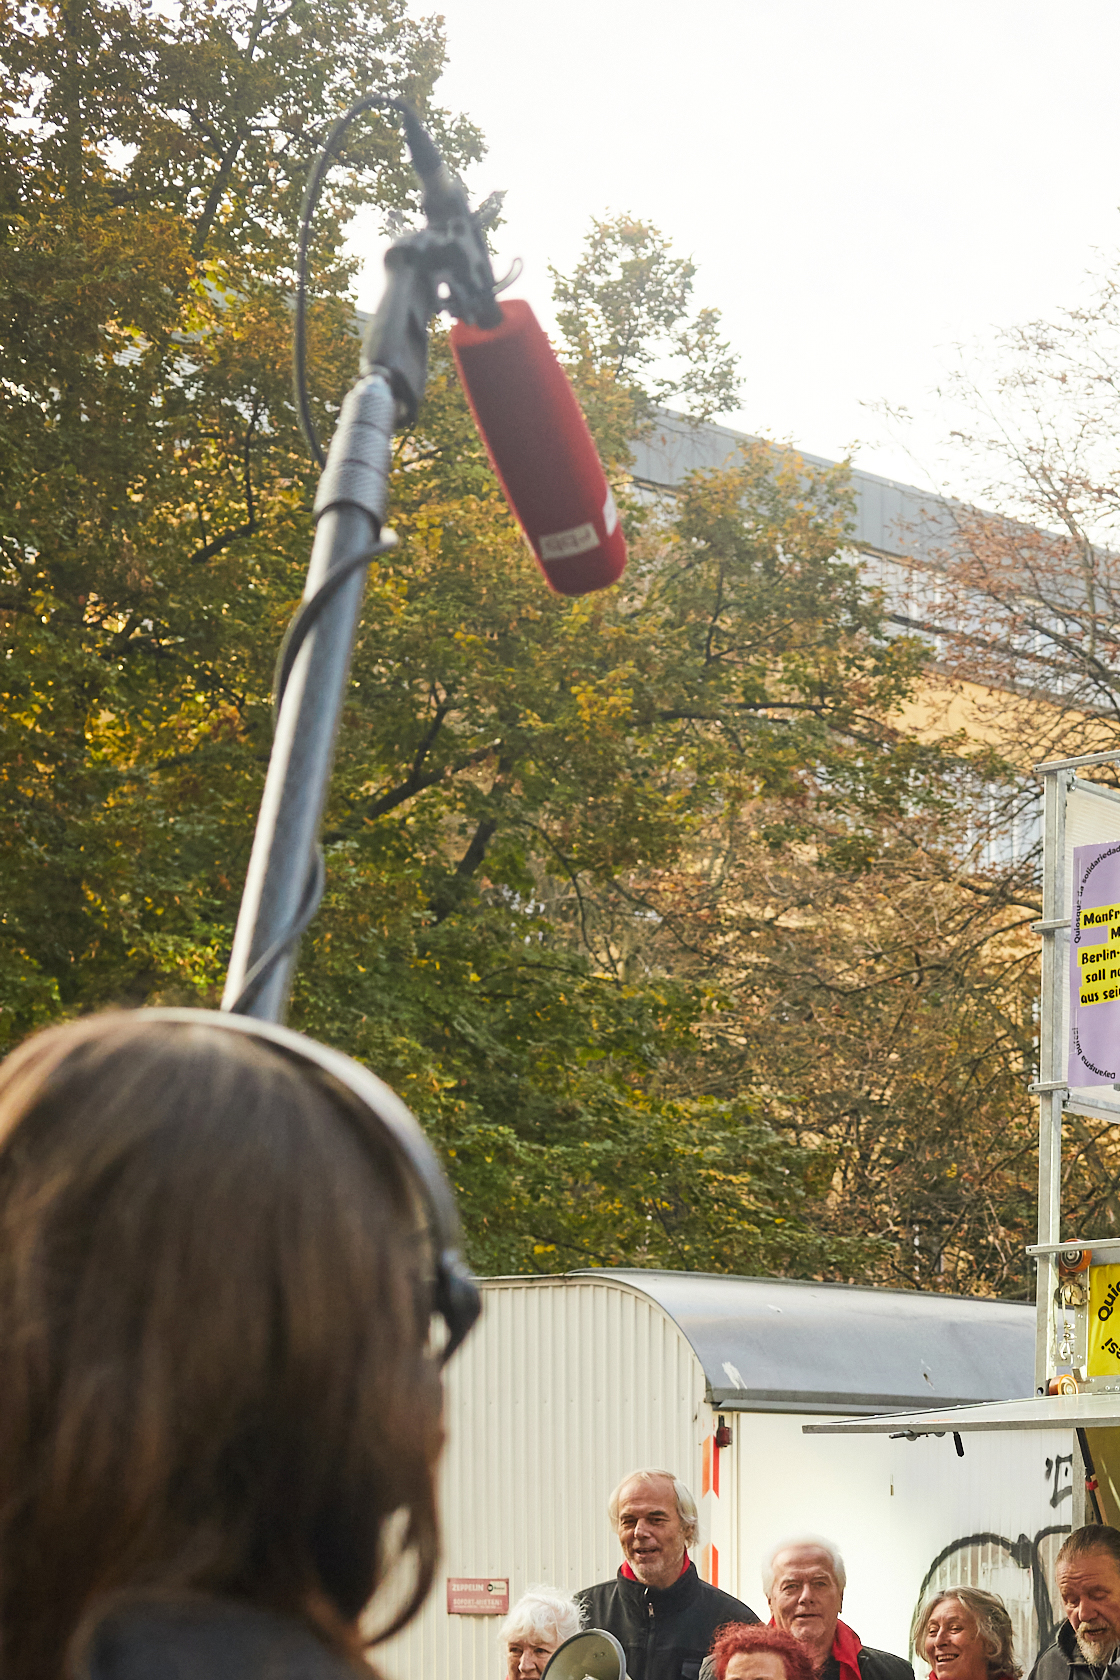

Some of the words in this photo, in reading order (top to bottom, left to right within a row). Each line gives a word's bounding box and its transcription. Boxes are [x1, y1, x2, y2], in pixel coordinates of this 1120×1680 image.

[1086, 969, 1106, 983] soll
[1081, 991, 1099, 1004] aus
[1081, 1055, 1116, 1079] Dayanışma
